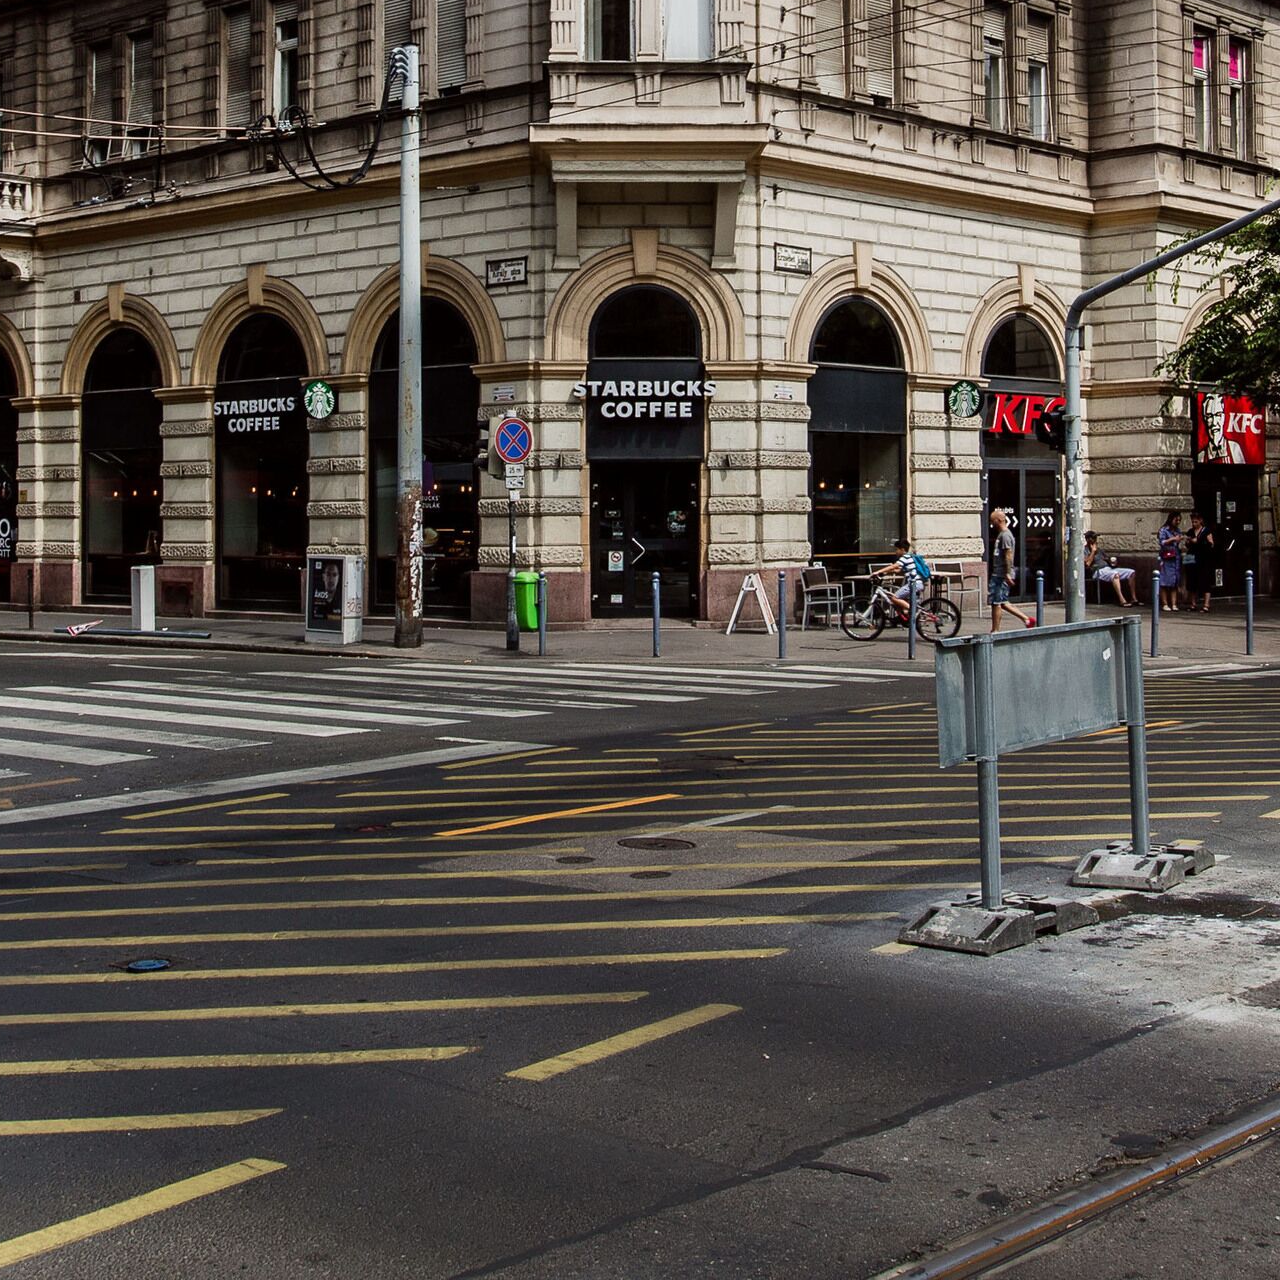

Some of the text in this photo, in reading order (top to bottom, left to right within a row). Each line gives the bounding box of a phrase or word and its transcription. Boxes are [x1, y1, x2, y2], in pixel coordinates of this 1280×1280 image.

[573, 380, 718, 397] STARBUCKS
[214, 397, 295, 416] STARBUCKS
[600, 401, 693, 418] COFFEE
[227, 416, 280, 433] COFFEE
[1227, 412, 1263, 434] KFC
